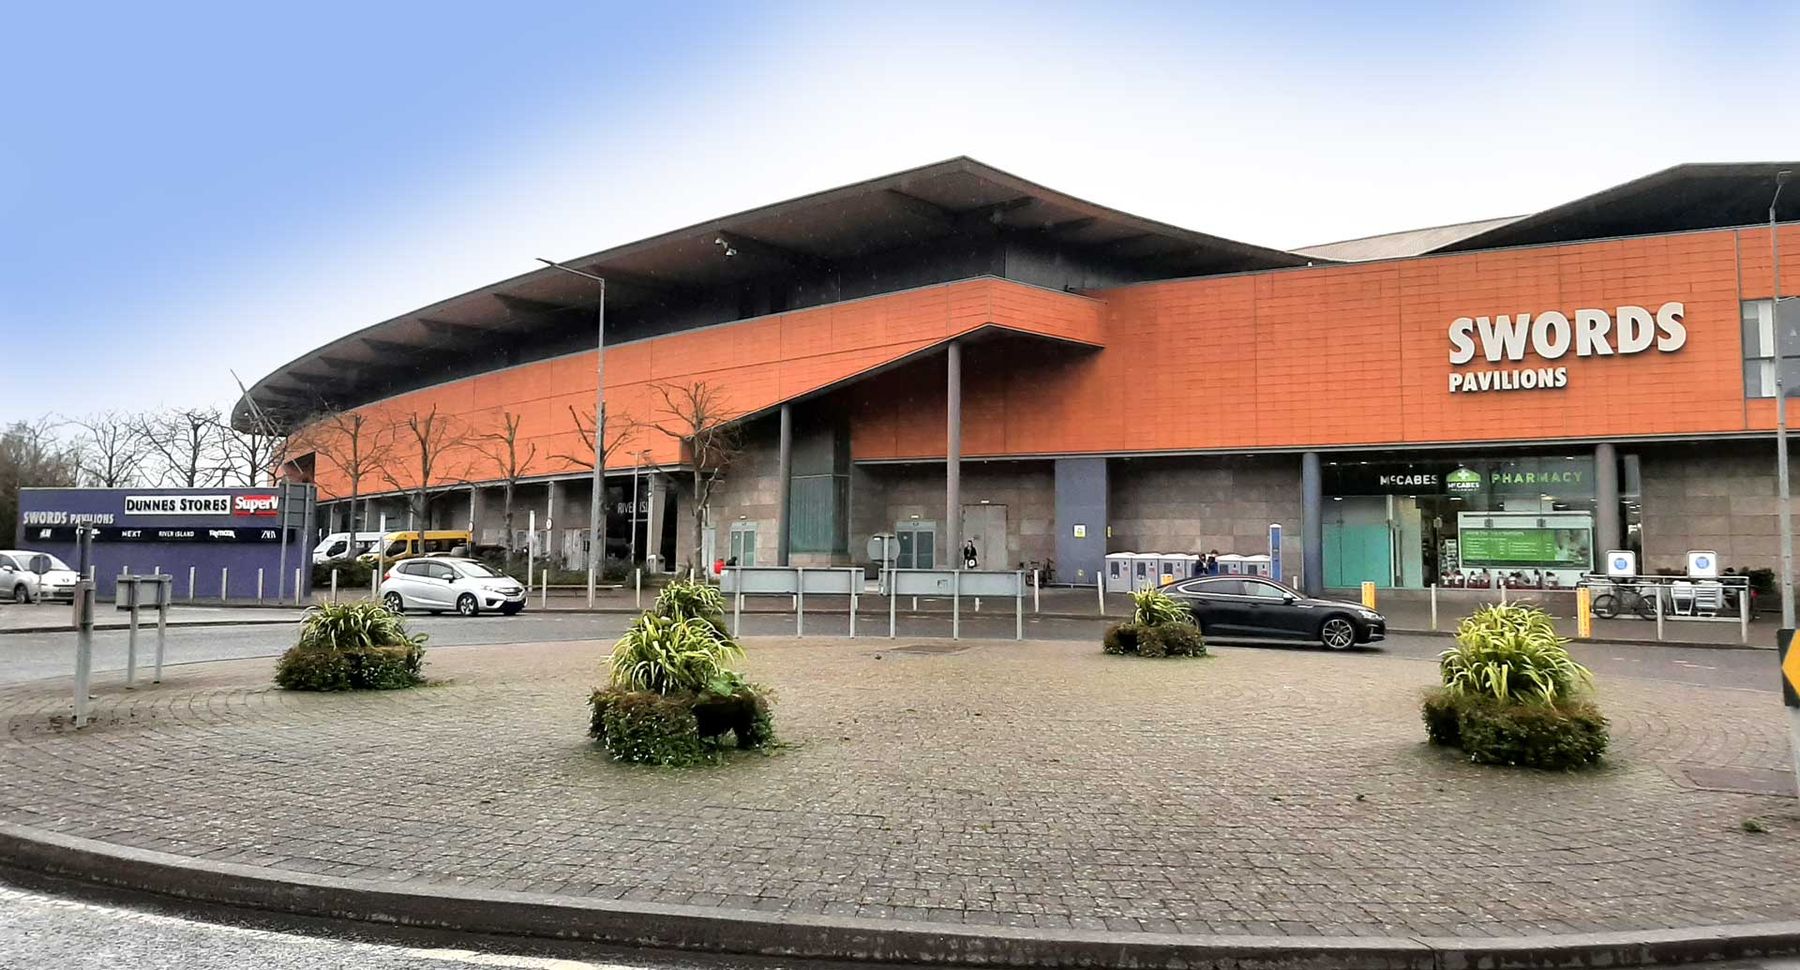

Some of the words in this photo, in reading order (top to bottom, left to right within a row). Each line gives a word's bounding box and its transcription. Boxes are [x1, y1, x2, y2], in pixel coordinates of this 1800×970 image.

[1448, 301, 1687, 365] SWORDS
[1448, 367, 1568, 393] PAVILIONS
[1380, 474, 1438, 485] McCABES
[1492, 472, 1582, 484] PHARMACY
[126, 498, 176, 512] DUNNES
[179, 498, 228, 512] STORES
[235, 495, 279, 513] SuperV
[618, 502, 635, 514] RIVE
[23, 512, 68, 524] SWORDS
